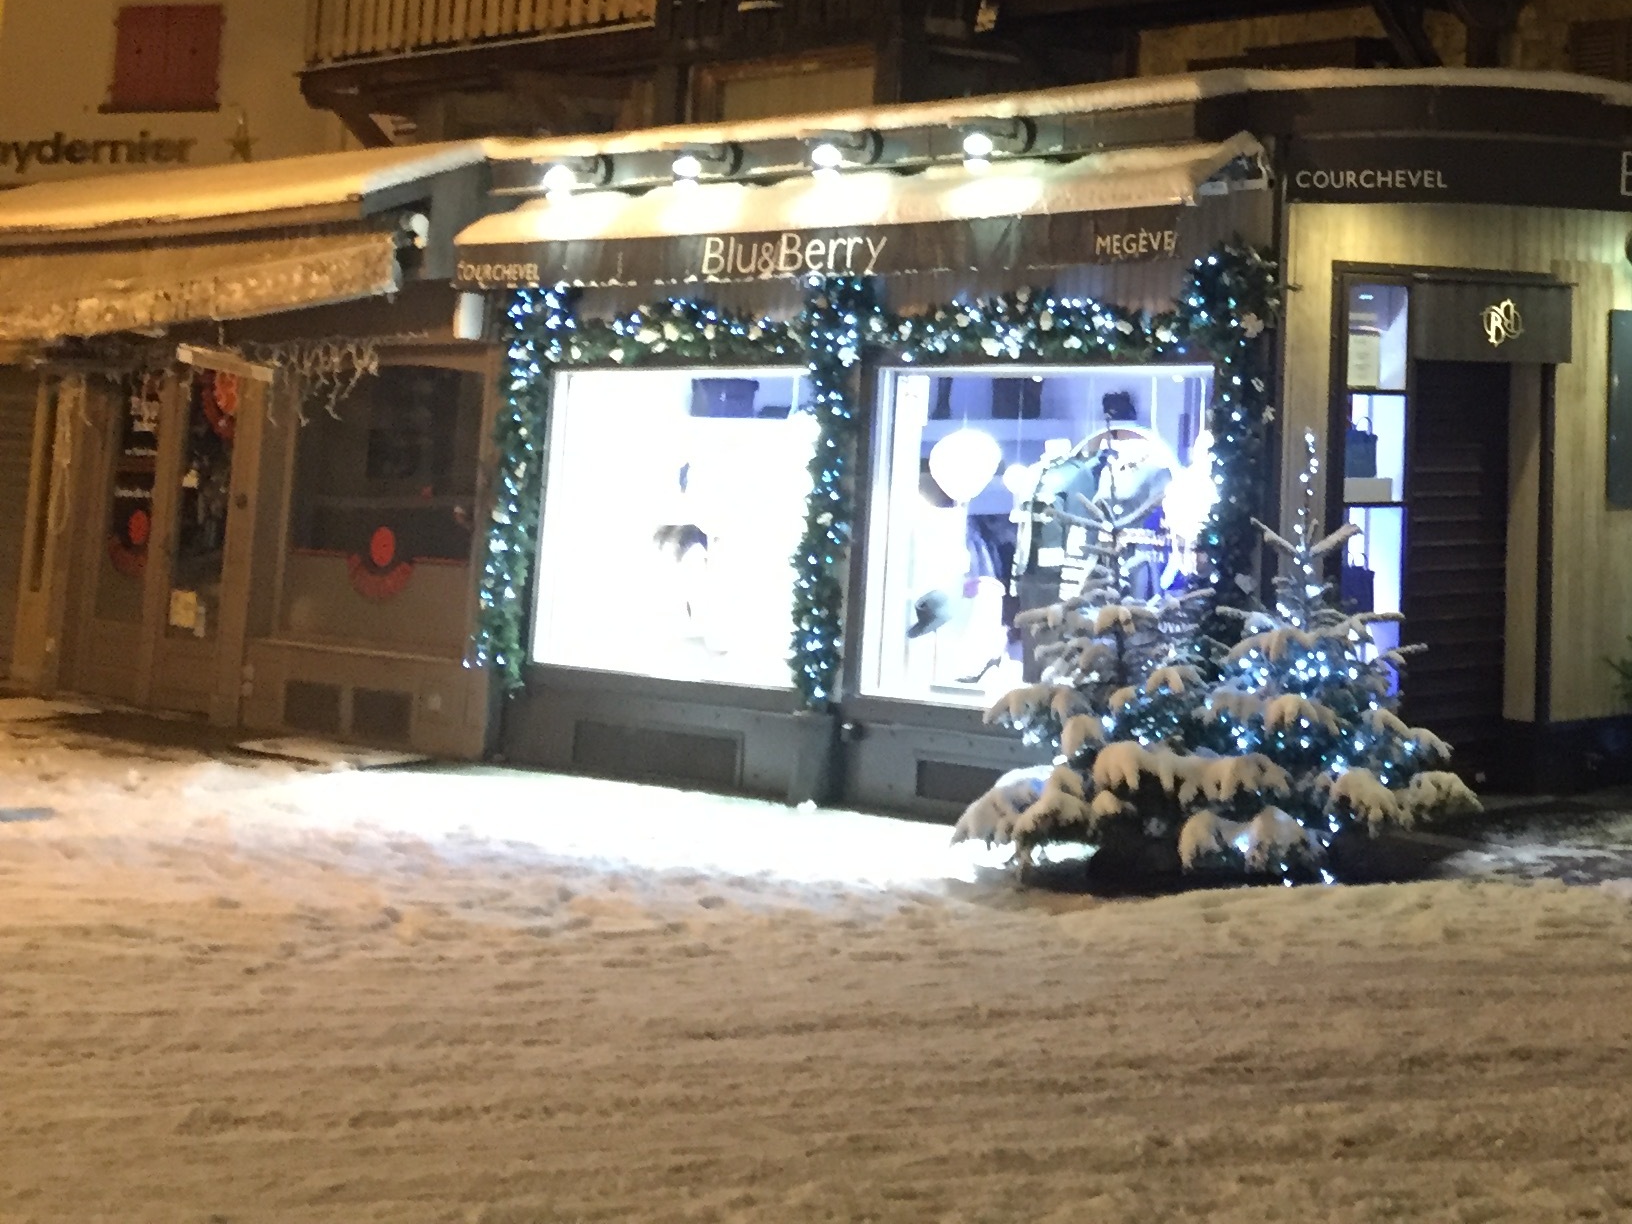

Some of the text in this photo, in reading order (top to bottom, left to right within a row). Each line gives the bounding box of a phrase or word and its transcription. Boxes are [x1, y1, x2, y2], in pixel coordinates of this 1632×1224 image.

[1295, 169, 1448, 189] COURCHEVEL
[701, 232, 888, 276] Blu&Berry
[1095, 227, 1177, 256] MEGÈVE
